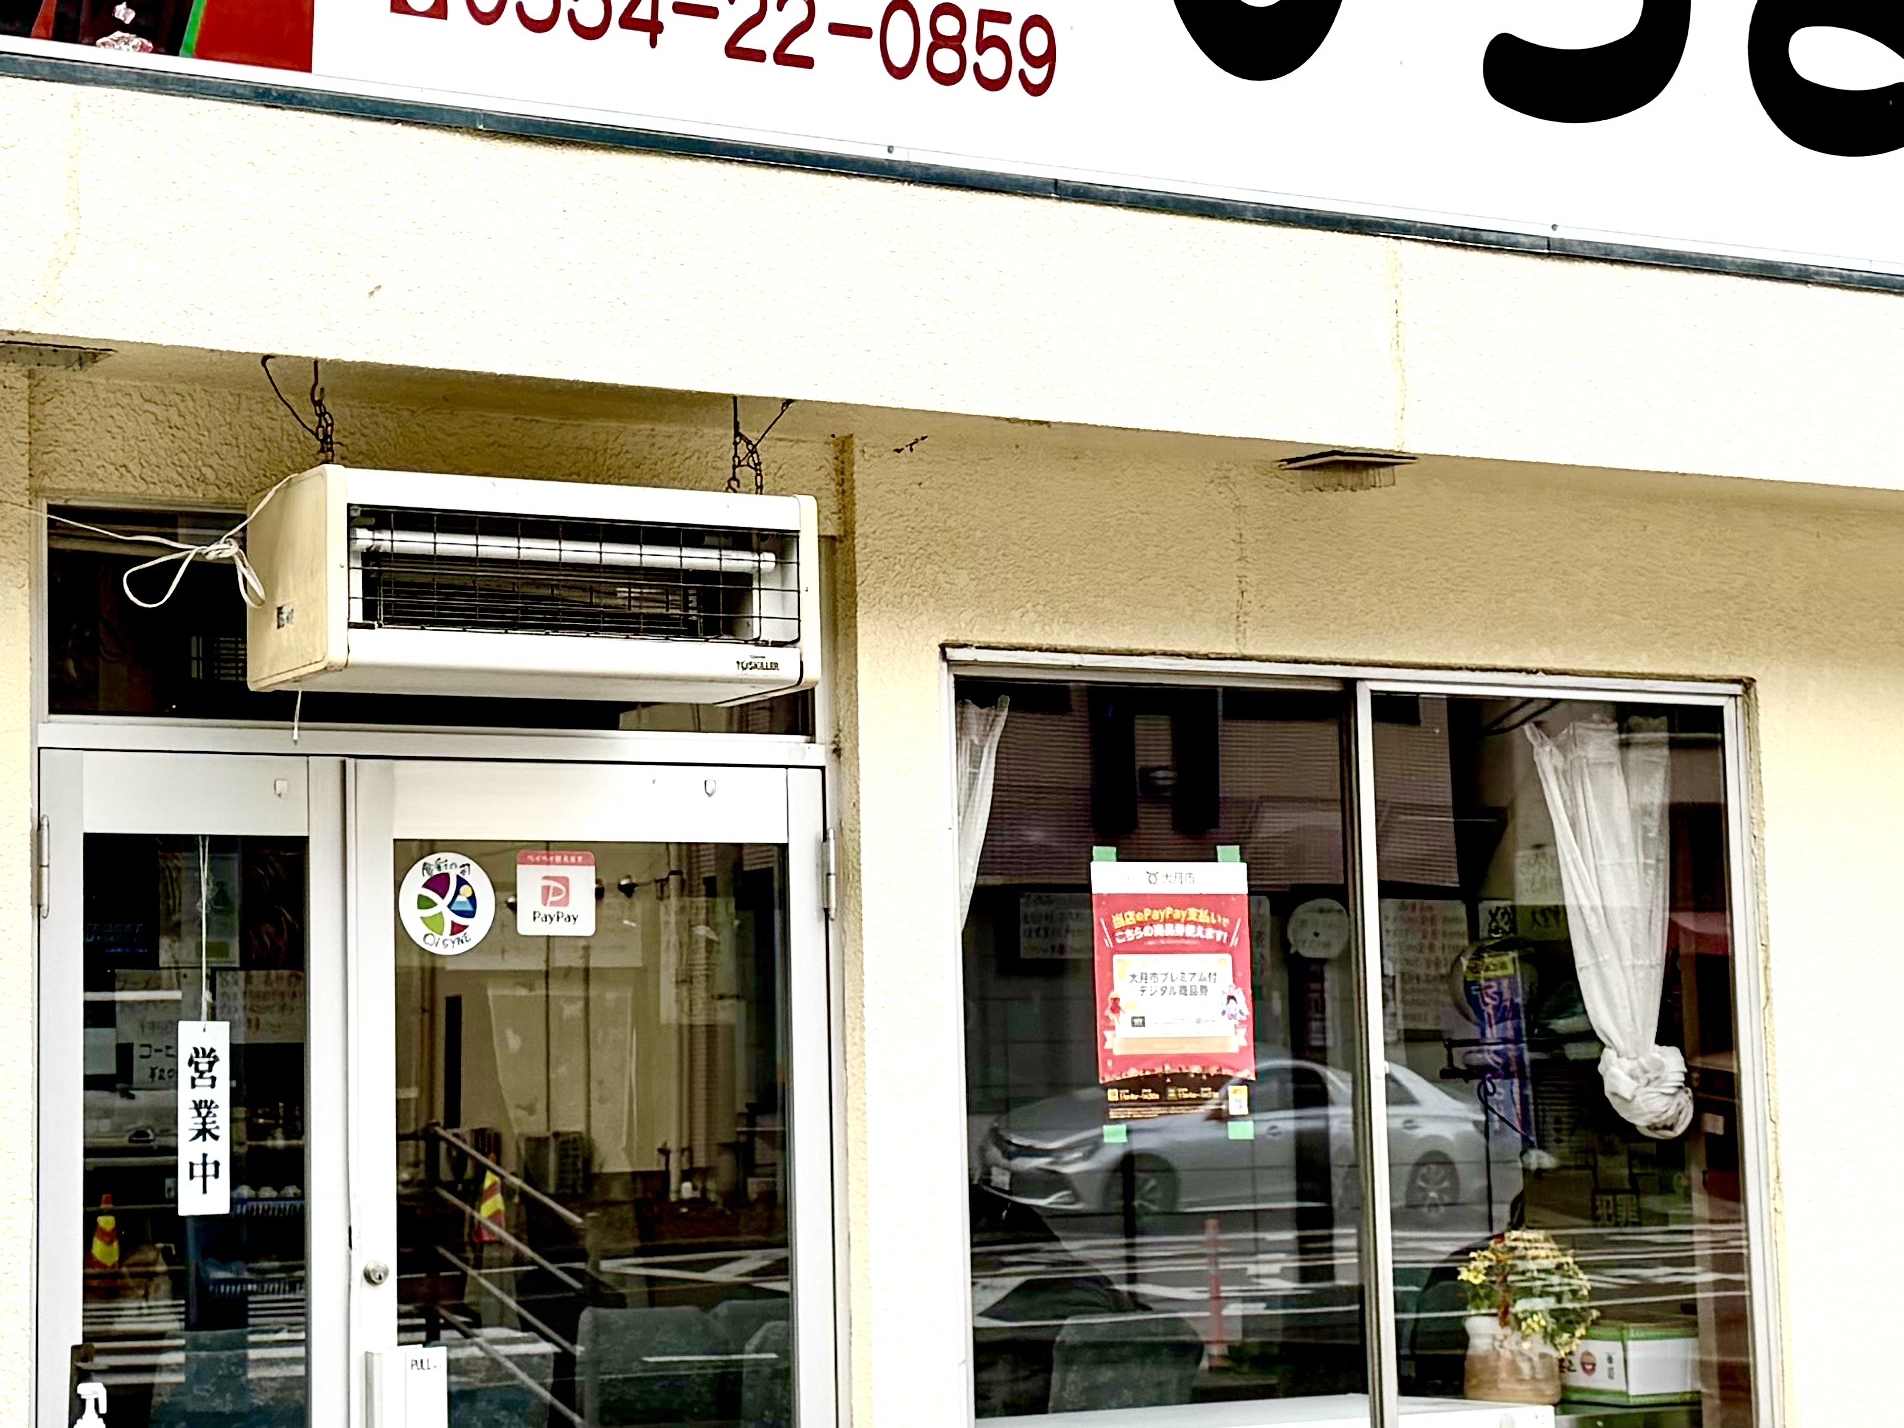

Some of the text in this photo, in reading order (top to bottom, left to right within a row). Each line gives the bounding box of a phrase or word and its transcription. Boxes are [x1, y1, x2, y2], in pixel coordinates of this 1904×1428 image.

[533, 910, 578, 924] PayPay
[187, 1046, 222, 1197] 営業中
